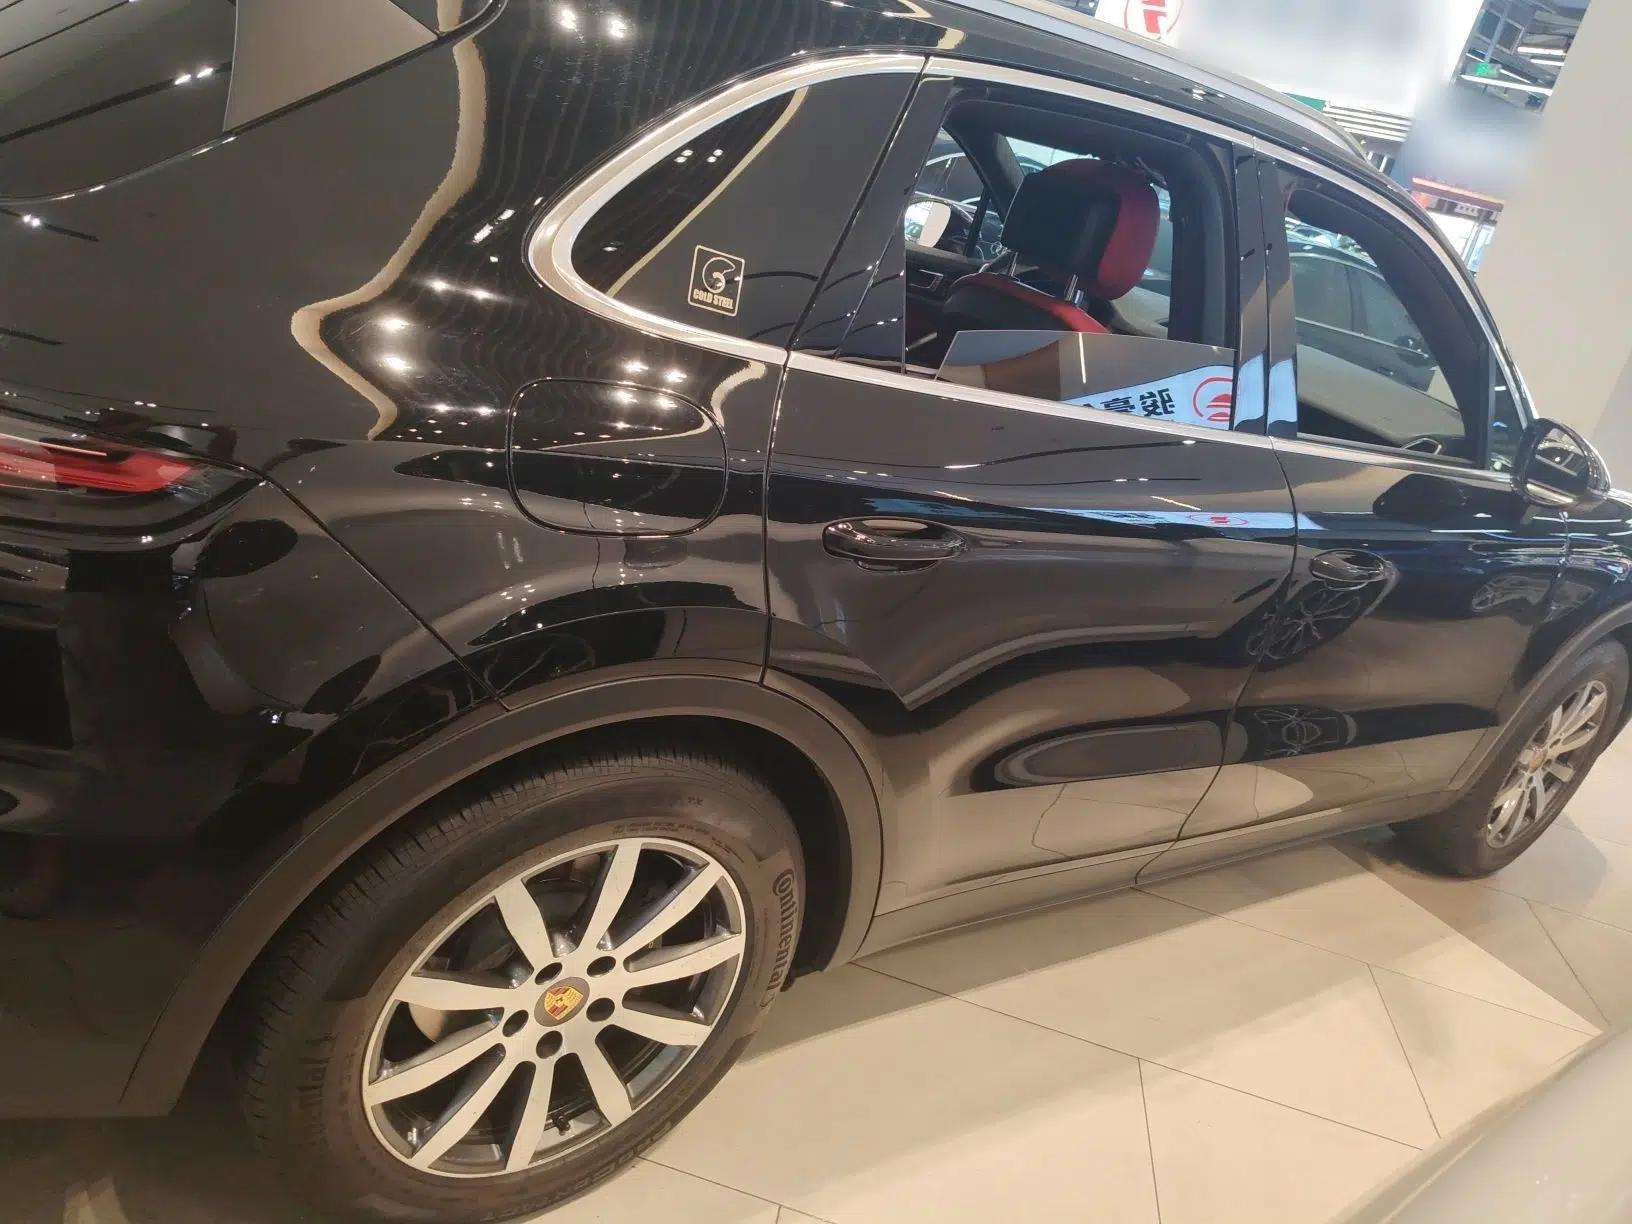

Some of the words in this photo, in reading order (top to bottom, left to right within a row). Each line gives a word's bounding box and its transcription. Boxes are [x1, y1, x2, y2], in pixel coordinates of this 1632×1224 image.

[693, 288, 713, 304] COLD
[713, 294, 734, 310] STEEL
[767, 868, 798, 991] Continental
